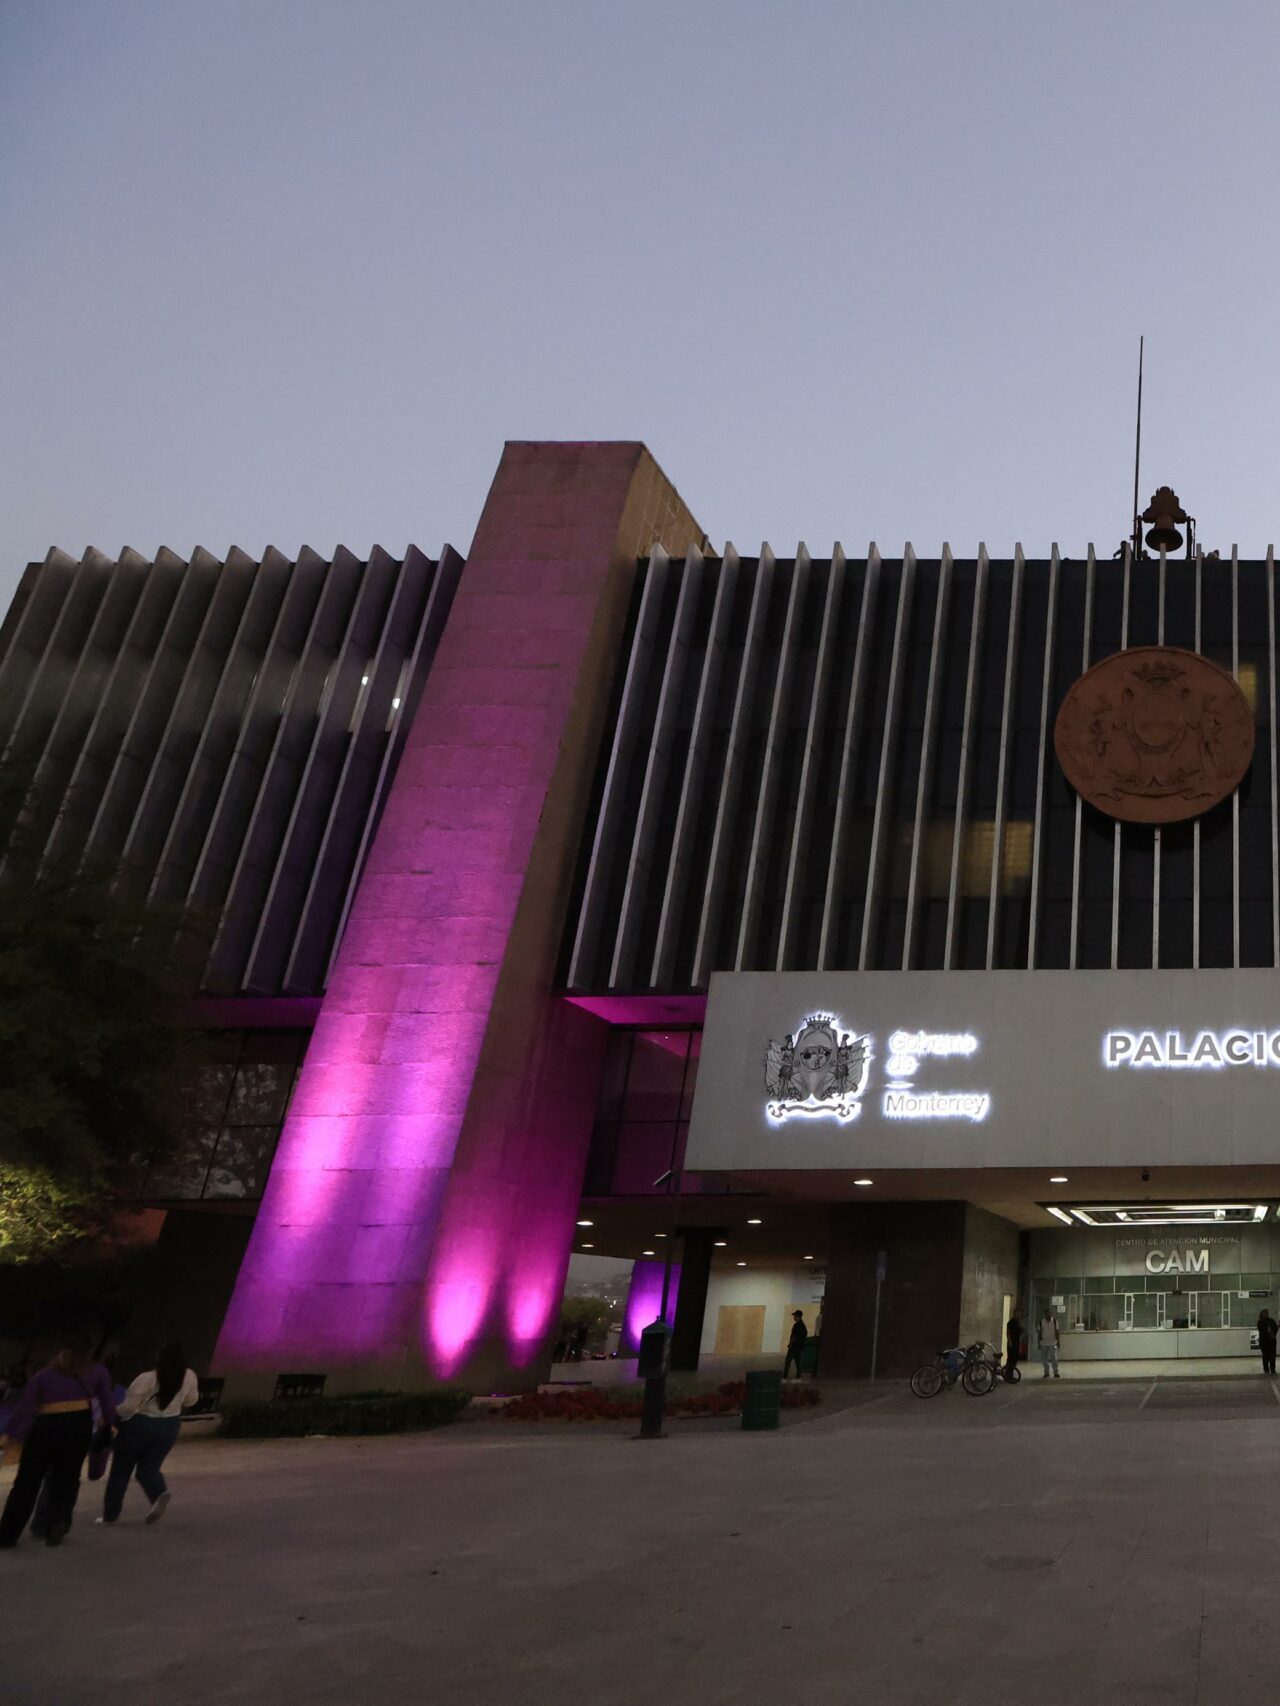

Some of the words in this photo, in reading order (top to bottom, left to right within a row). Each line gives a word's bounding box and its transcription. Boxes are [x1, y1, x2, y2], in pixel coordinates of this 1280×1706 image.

[886, 1094, 986, 1115] Monterrey
[1115, 1239, 1146, 1247] CENTRO
[1199, 1236, 1240, 1245] MUNICIPAL
[1145, 1249, 1210, 1274] CAM
